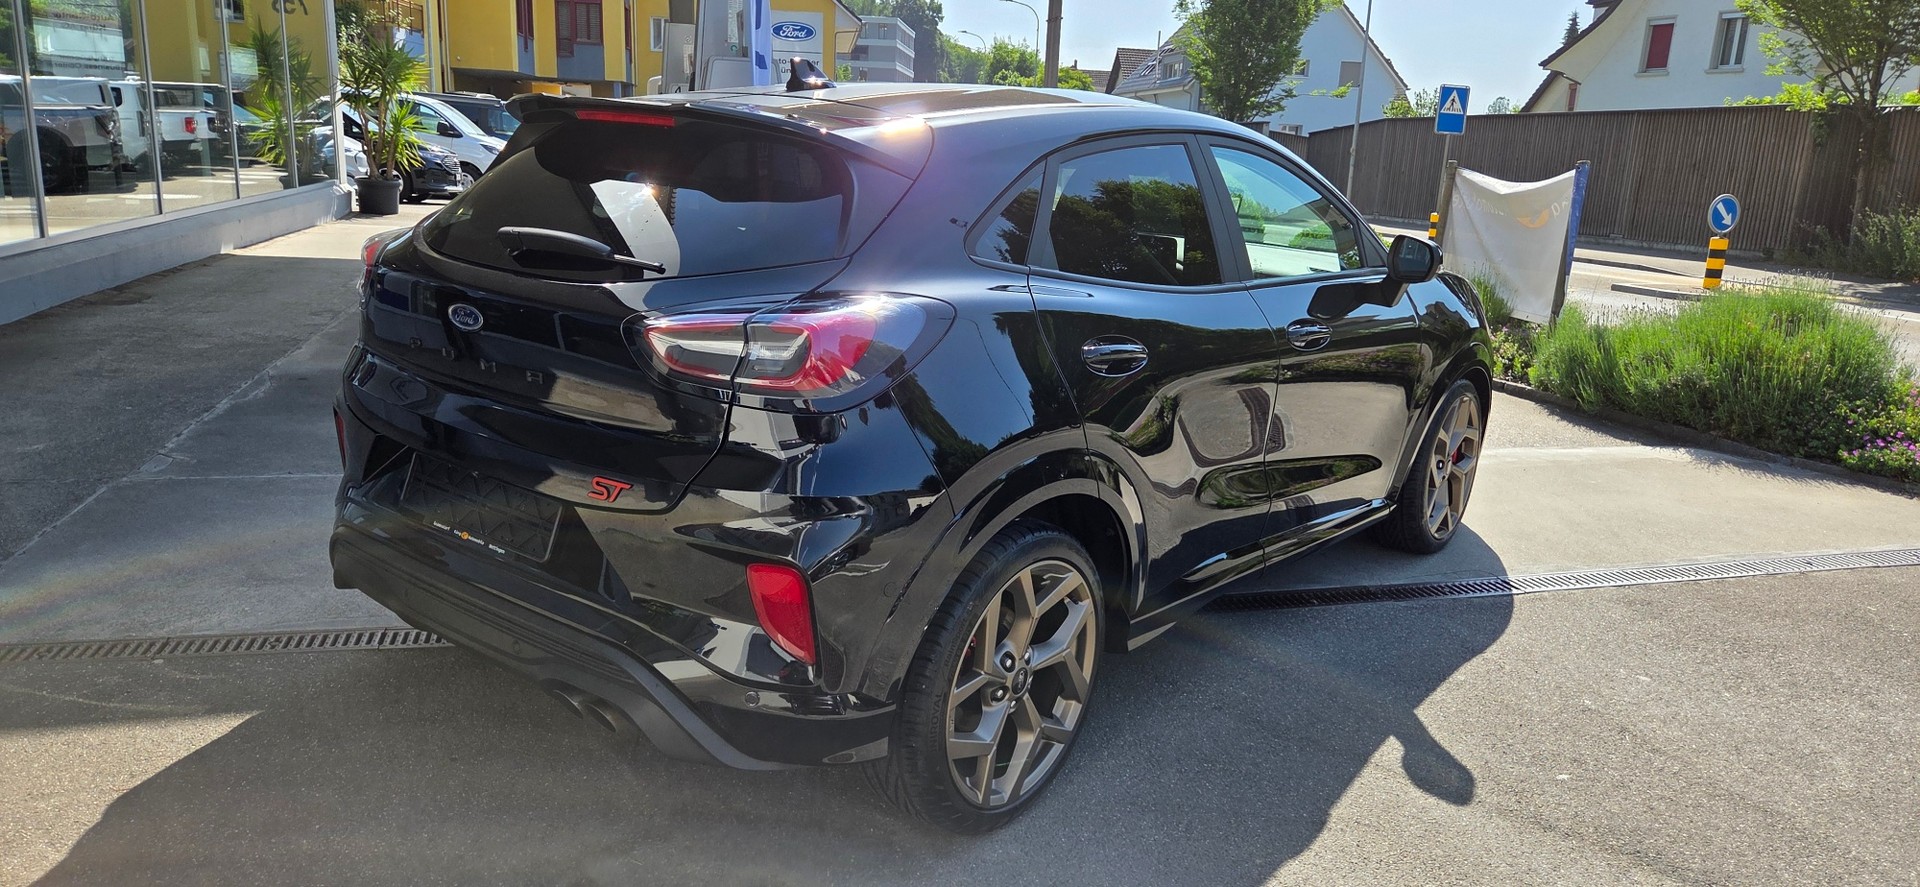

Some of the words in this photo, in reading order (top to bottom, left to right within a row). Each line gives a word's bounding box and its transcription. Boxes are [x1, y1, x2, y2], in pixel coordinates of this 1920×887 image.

[780, 25, 807, 38] Ford
[456, 307, 475, 325] Ford
[409, 337, 543, 384] PUMA
[587, 476, 634, 503] ST
